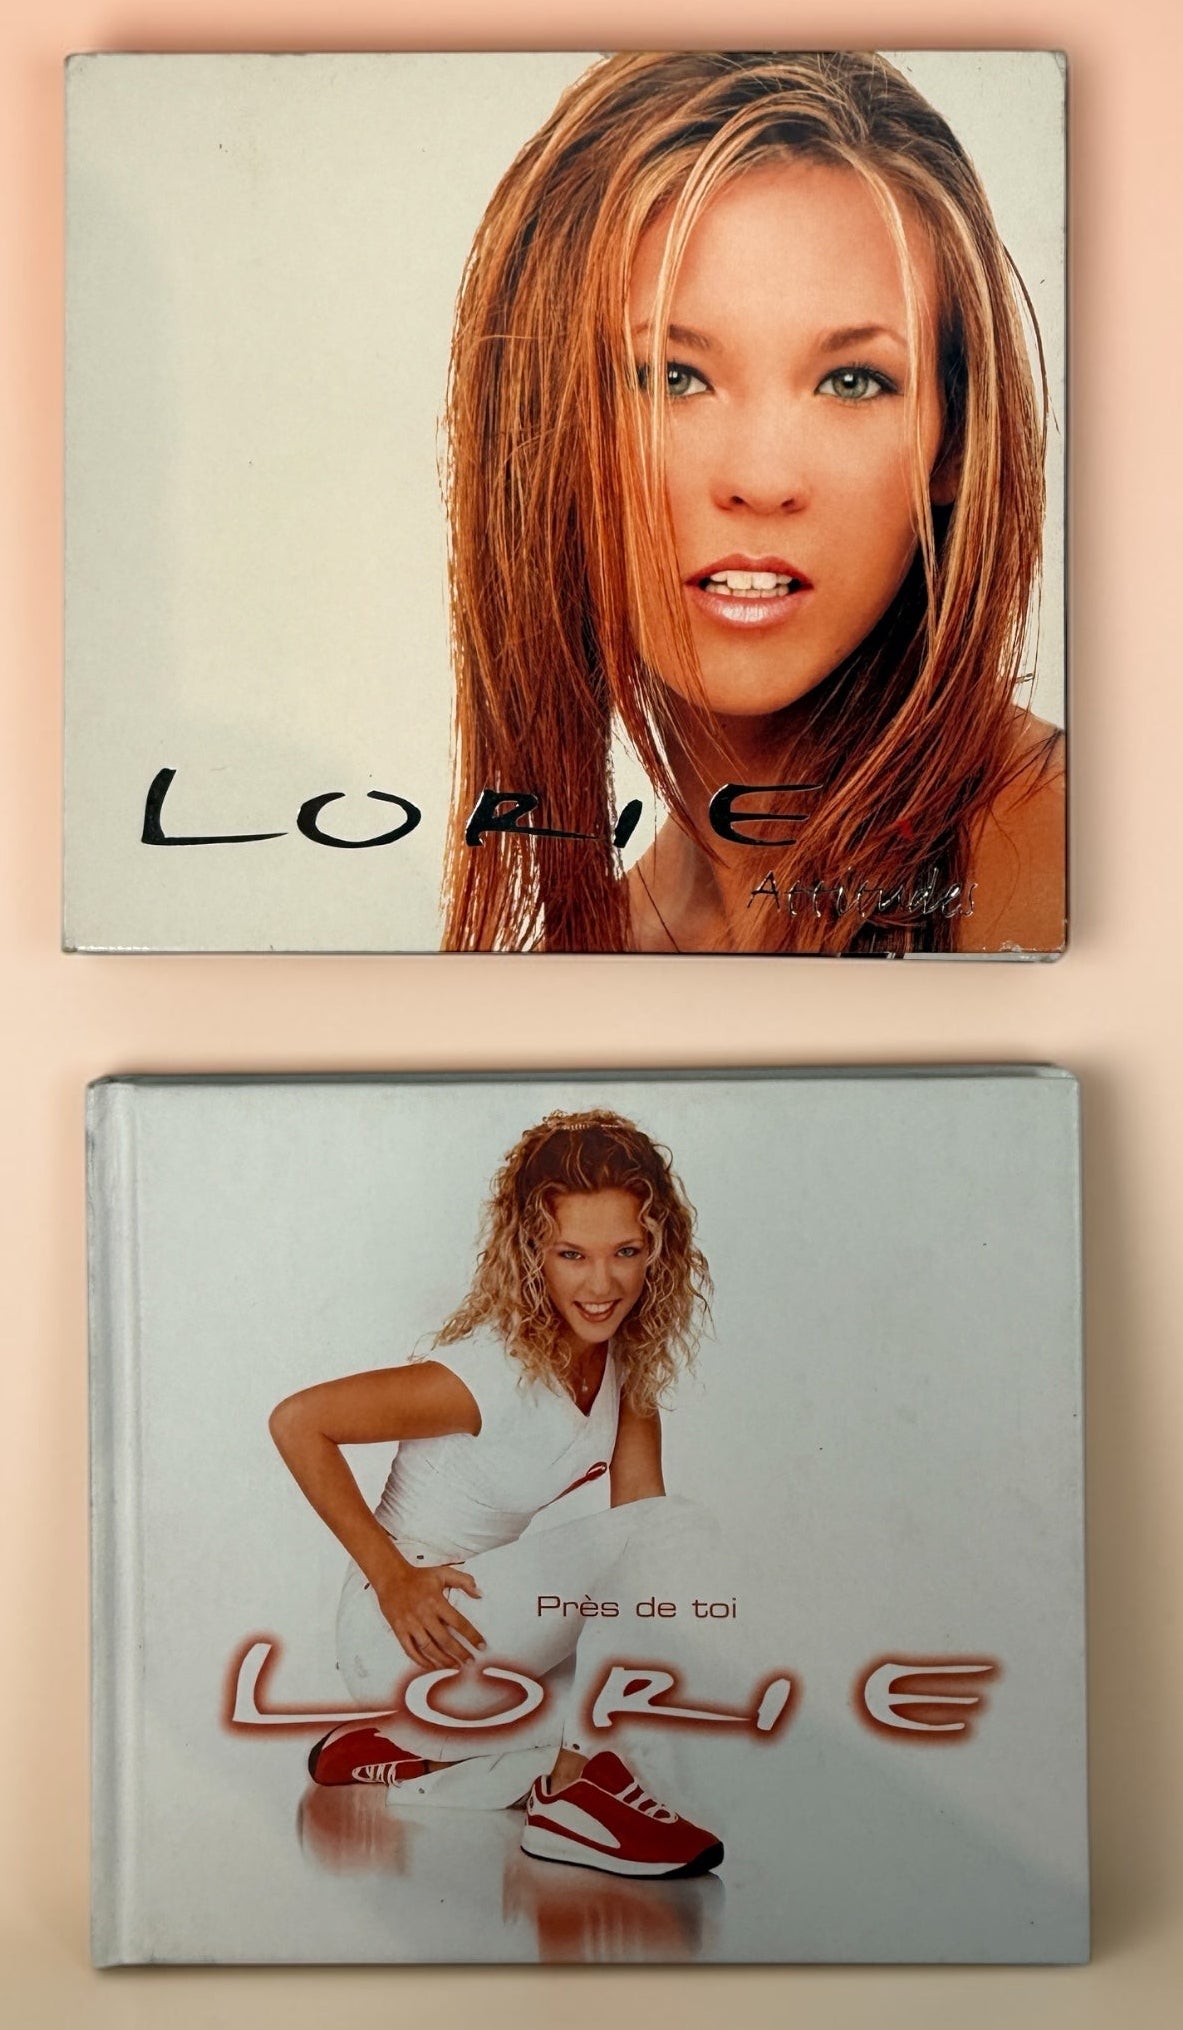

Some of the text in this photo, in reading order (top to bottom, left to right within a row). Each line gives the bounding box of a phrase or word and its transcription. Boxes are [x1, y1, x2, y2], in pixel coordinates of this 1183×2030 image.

[140, 767, 824, 849] LORIE
[746, 865, 980, 919] Attitudes
[536, 1593, 737, 1619] Près de toi
[229, 1640, 997, 1733] LORIE
